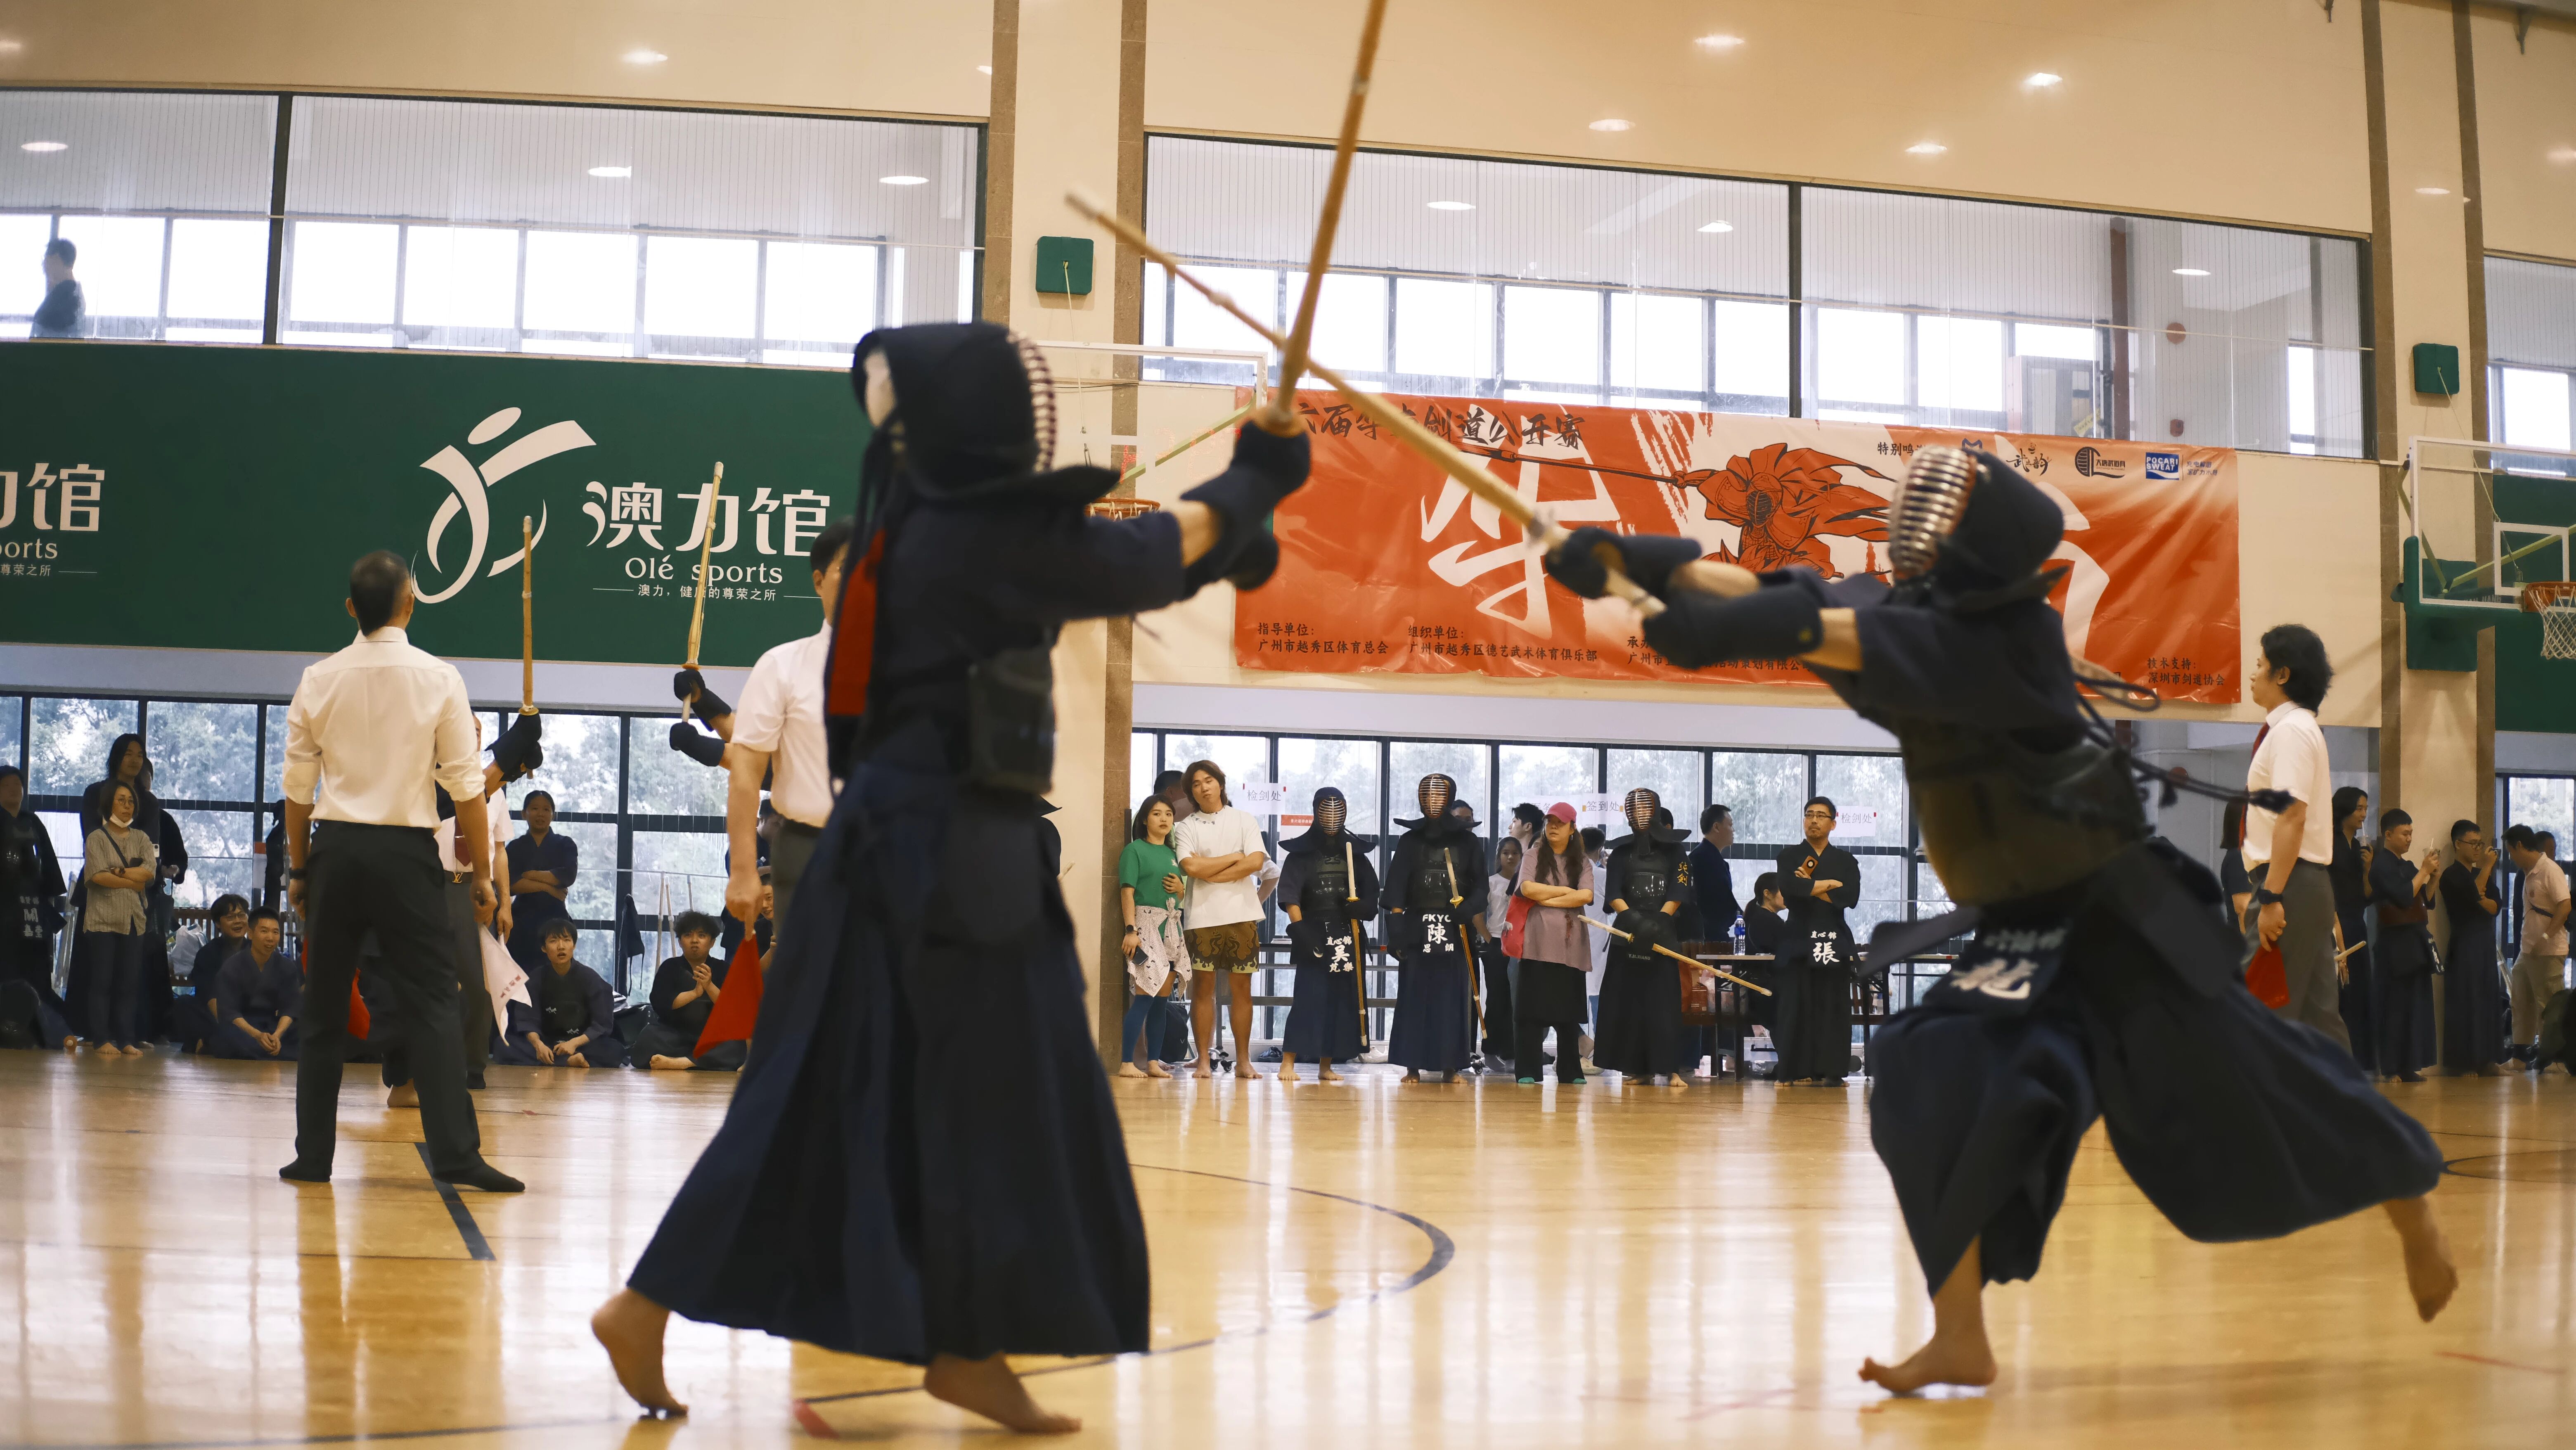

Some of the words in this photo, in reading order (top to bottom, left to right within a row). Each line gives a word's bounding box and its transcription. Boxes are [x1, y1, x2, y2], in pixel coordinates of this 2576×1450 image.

[1878, 442, 1925, 456] 特别鸣
[2147, 457, 2178, 465] POCARI
[0, 463, 105, 531] 馆
[582, 481, 830, 556] 澳力馆
[0, 538, 58, 559] orts
[625, 554, 674, 580] Olé
[691, 563, 783, 587] sports
[1258, 639, 1389, 654] 广州市越秀区体育总会
[1409, 642, 1597, 662] 广州市越秀区德艺武术体育俱乐部
[2148, 672, 2225, 685] 深圳市剑道协会
[1247, 790, 1281, 801] 检剑处
[1586, 801, 1619, 811] 签到处
[1842, 813, 1872, 823] 检剑处
[1427, 922, 1448, 944] 陳
[1813, 942, 1840, 965] 張
